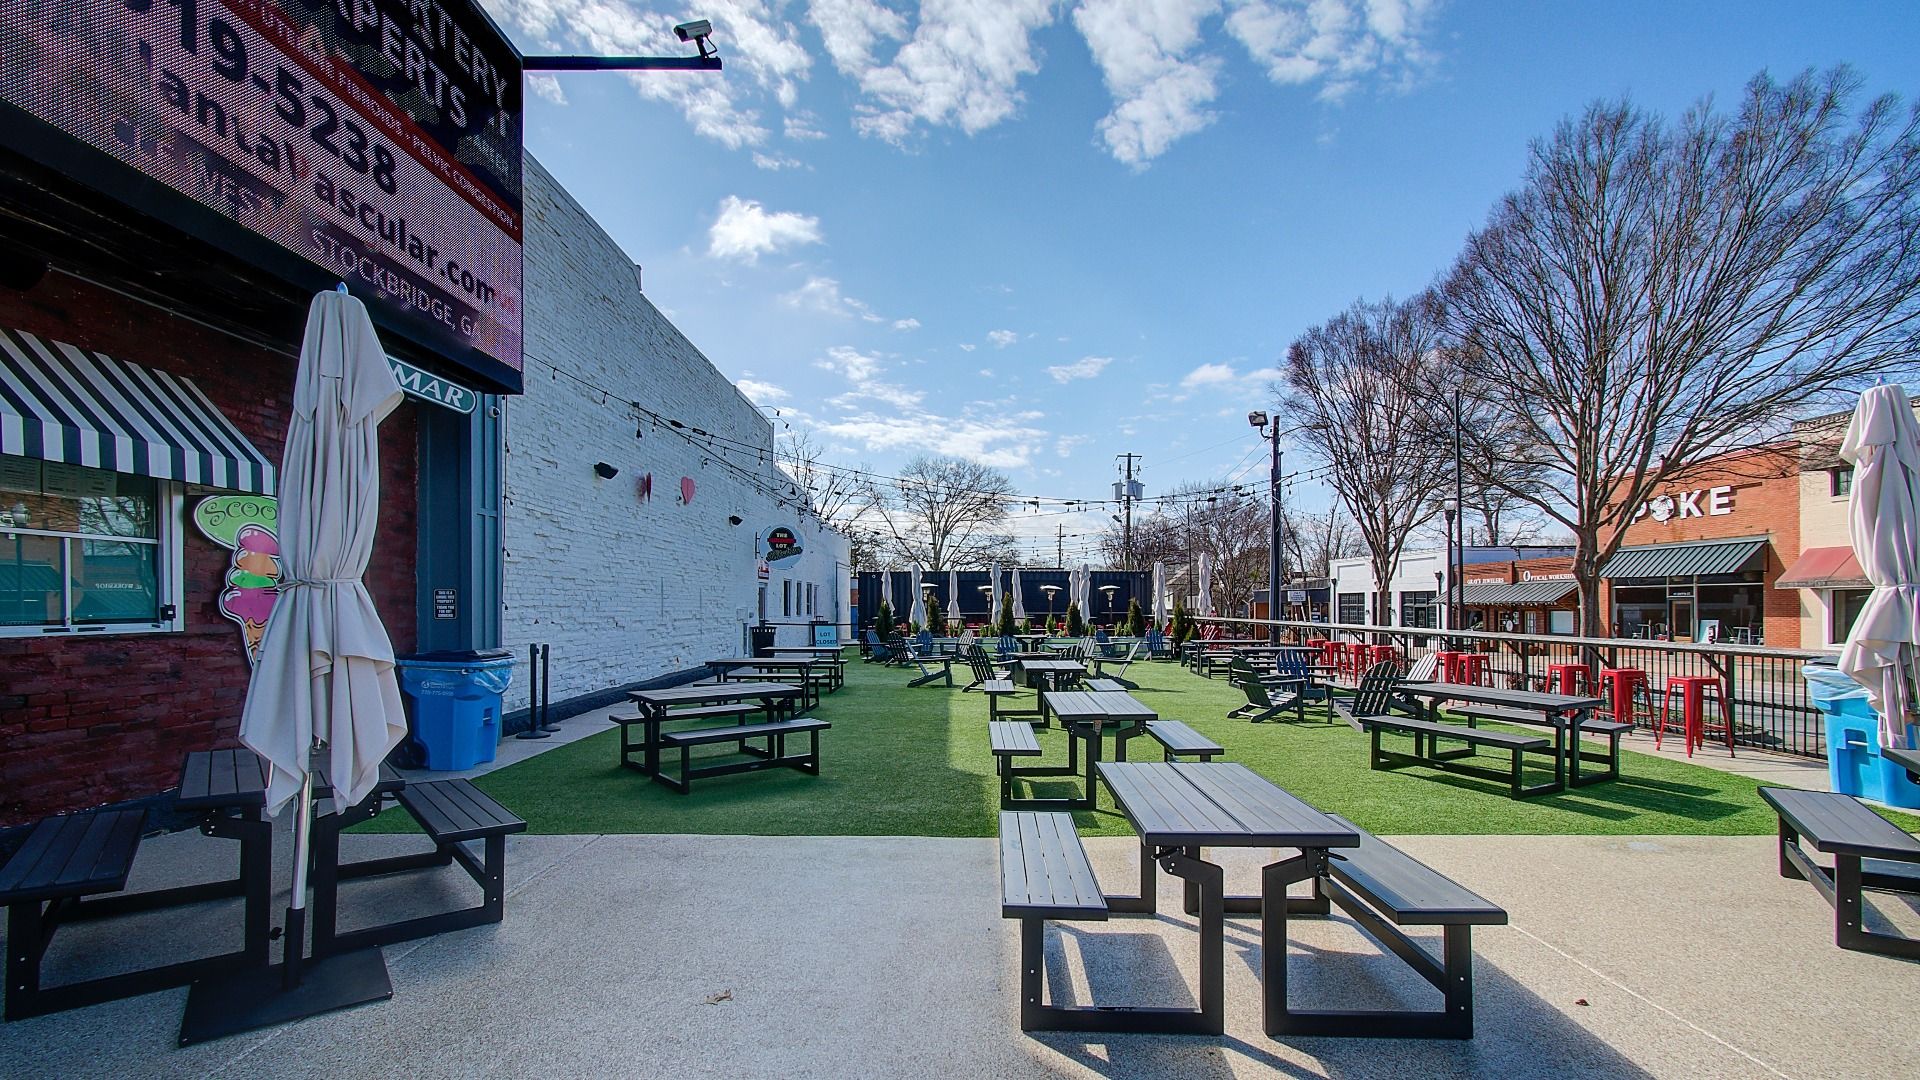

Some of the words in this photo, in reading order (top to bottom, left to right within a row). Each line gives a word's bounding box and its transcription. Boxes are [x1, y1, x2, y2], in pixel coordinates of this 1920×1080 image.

[123, 0, 397, 196] 19-5238
[338, 0, 467, 128] PERTS
[400, 0, 507, 107] RTERY
[411, 133, 451, 178] PELVIC
[452, 169, 514, 229] CONGESTION
[312, 227, 456, 332] STOCKBRIDGE,
